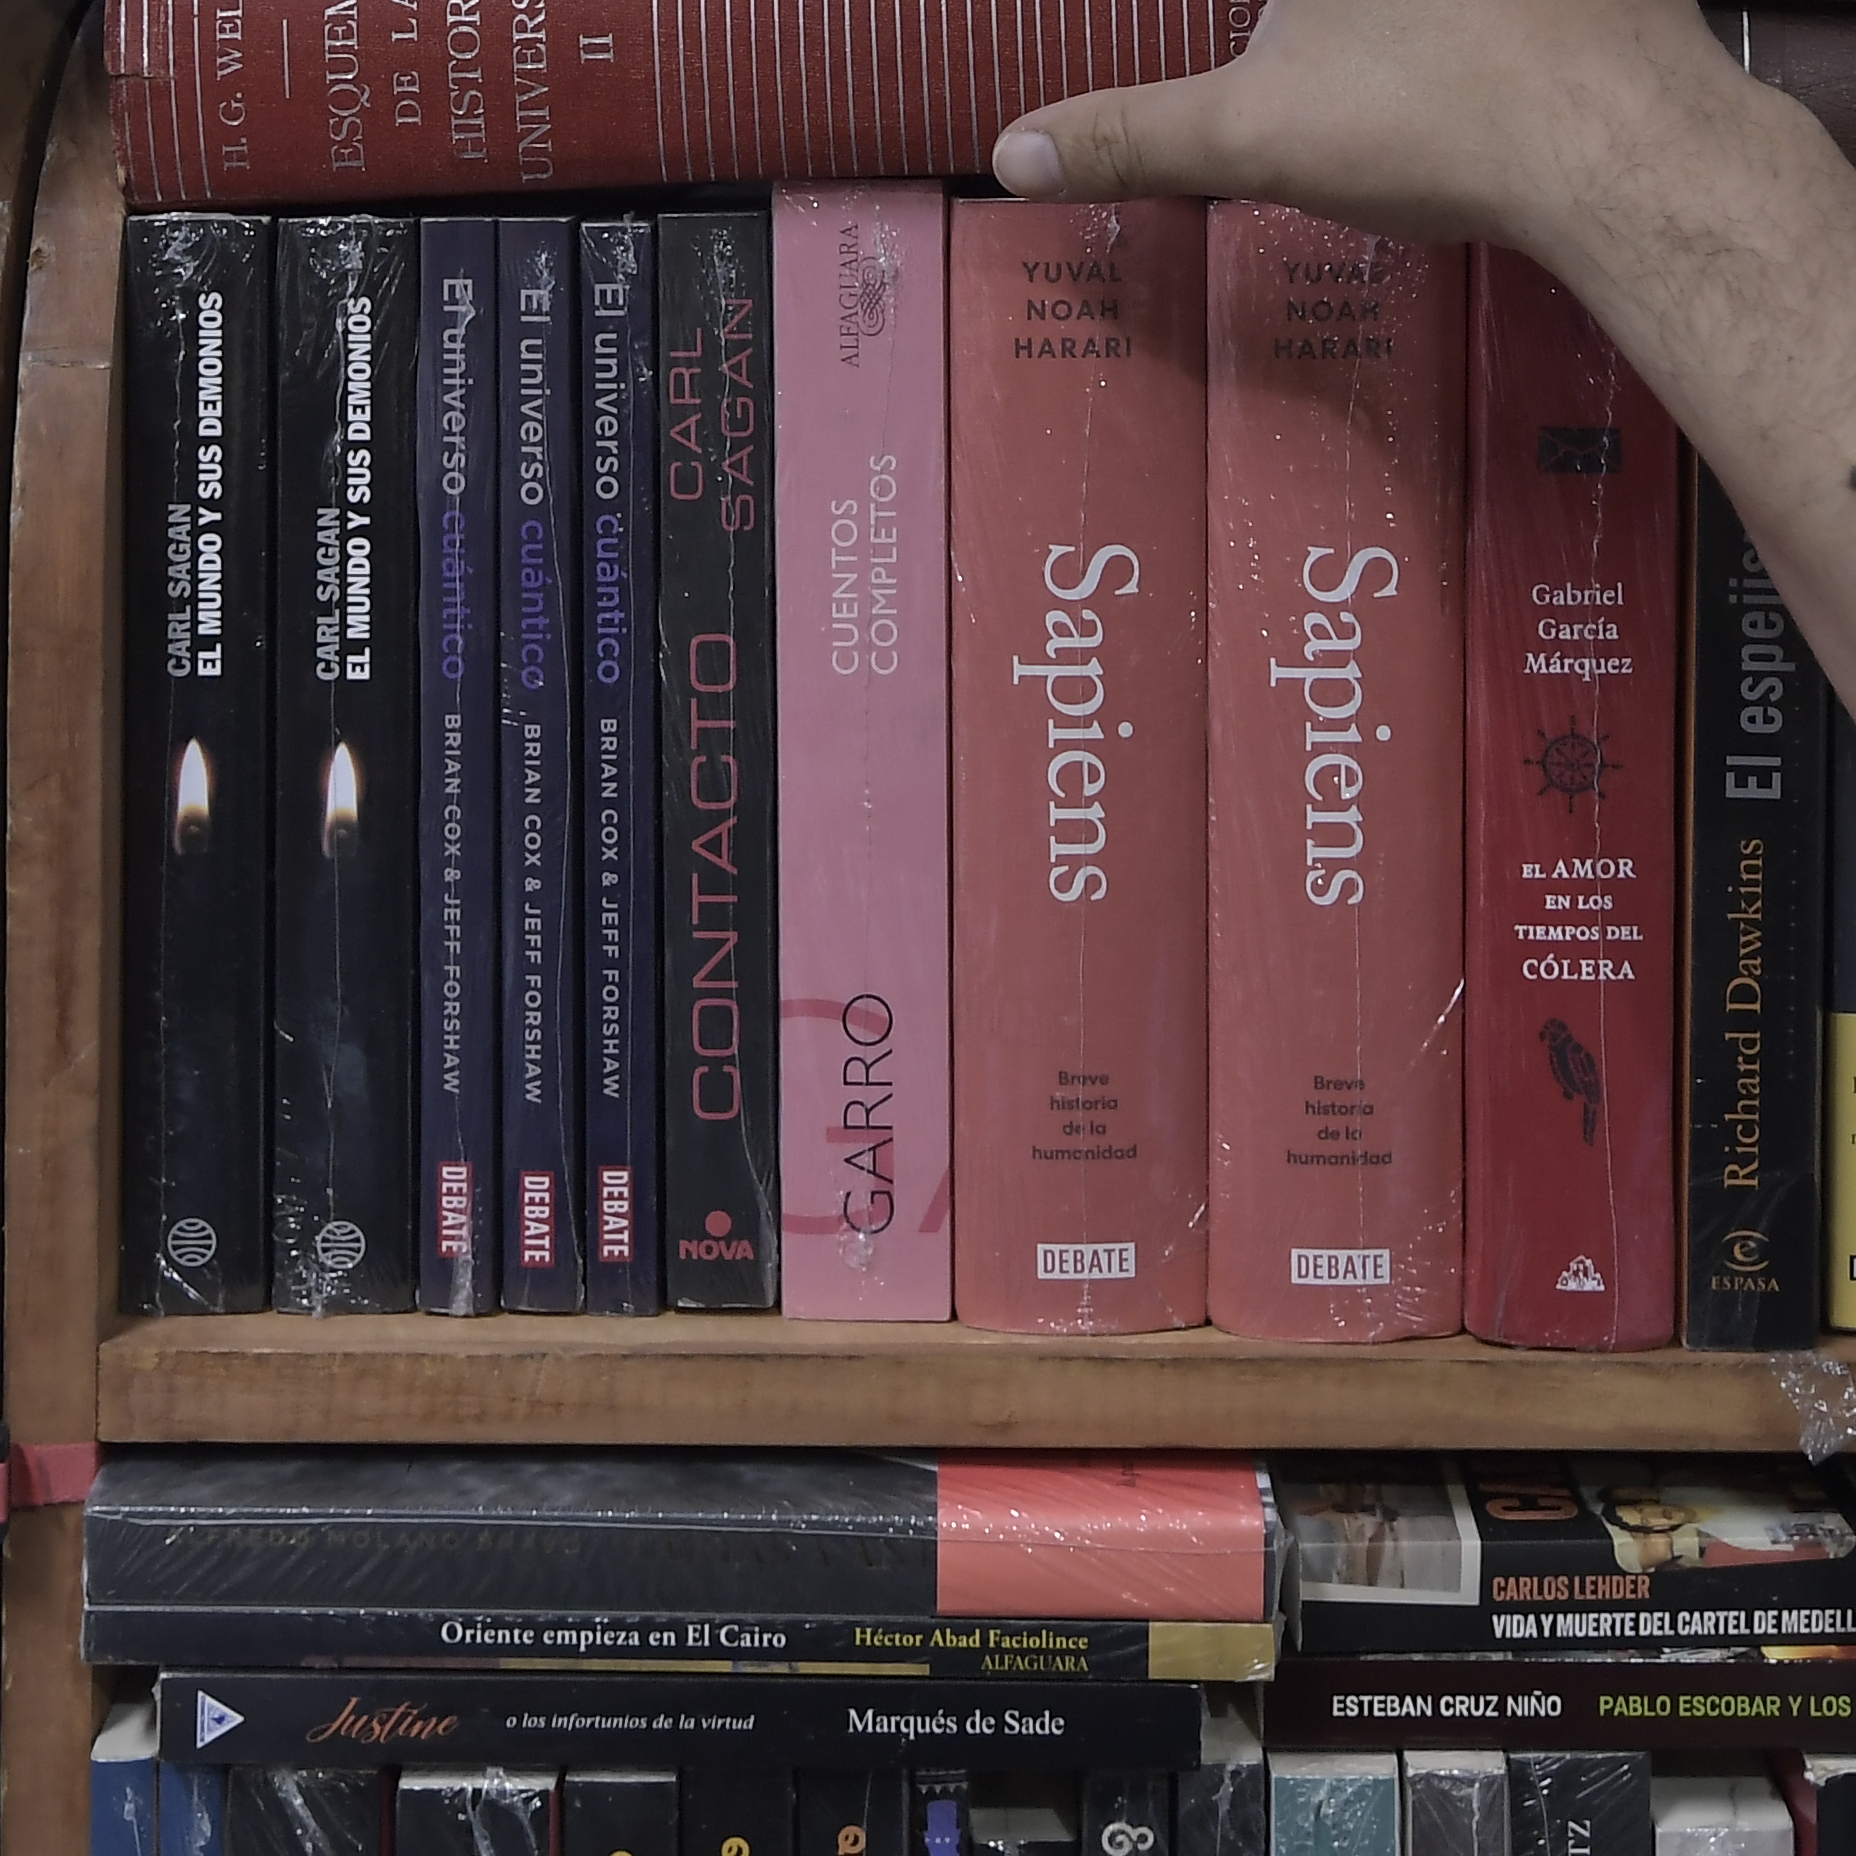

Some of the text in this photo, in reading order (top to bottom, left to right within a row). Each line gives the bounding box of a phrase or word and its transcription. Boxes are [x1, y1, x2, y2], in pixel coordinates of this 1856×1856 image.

[579, 33, 614, 64] II
[393, 71, 422, 126] DE
[198, 291, 223, 676] EL MUNDO Y SUS DEMONIOS
[870, 454, 898, 675] COMPLETOS
[167, 504, 191, 677] CARL SAGAN
[831, 499, 858, 675] CUENTOS
[1532, 583, 1624, 606] Gabriel
[1538, 616, 1619, 641] García
[1524, 652, 1633, 682] Márquez
[1012, 544, 1140, 904] Sapiens
[690, 632, 740, 1121] CONTACTO
[601, 718, 619, 1099] BRIAN COX & JEFF FORSHAW
[1522, 953, 1636, 981] CÓLERA
[1723, 838, 1764, 1190] Richard Dawkins
[842, 993, 894, 1236] GARRO
[680, 1239, 754, 1260] NOVA
[1043, 1248, 1130, 1274] DEBATE
[1710, 1274, 1781, 1292] ESPASA
[1492, 1574, 1651, 1602] CARLOS LEHDER
[441, 1620, 787, 1652] Oriente empieza en El Cairo
[1331, 1688, 1562, 1718] ESTEBAN CRUZ NIÑO
[847, 1708, 1064, 1740] Marqués de Sade
